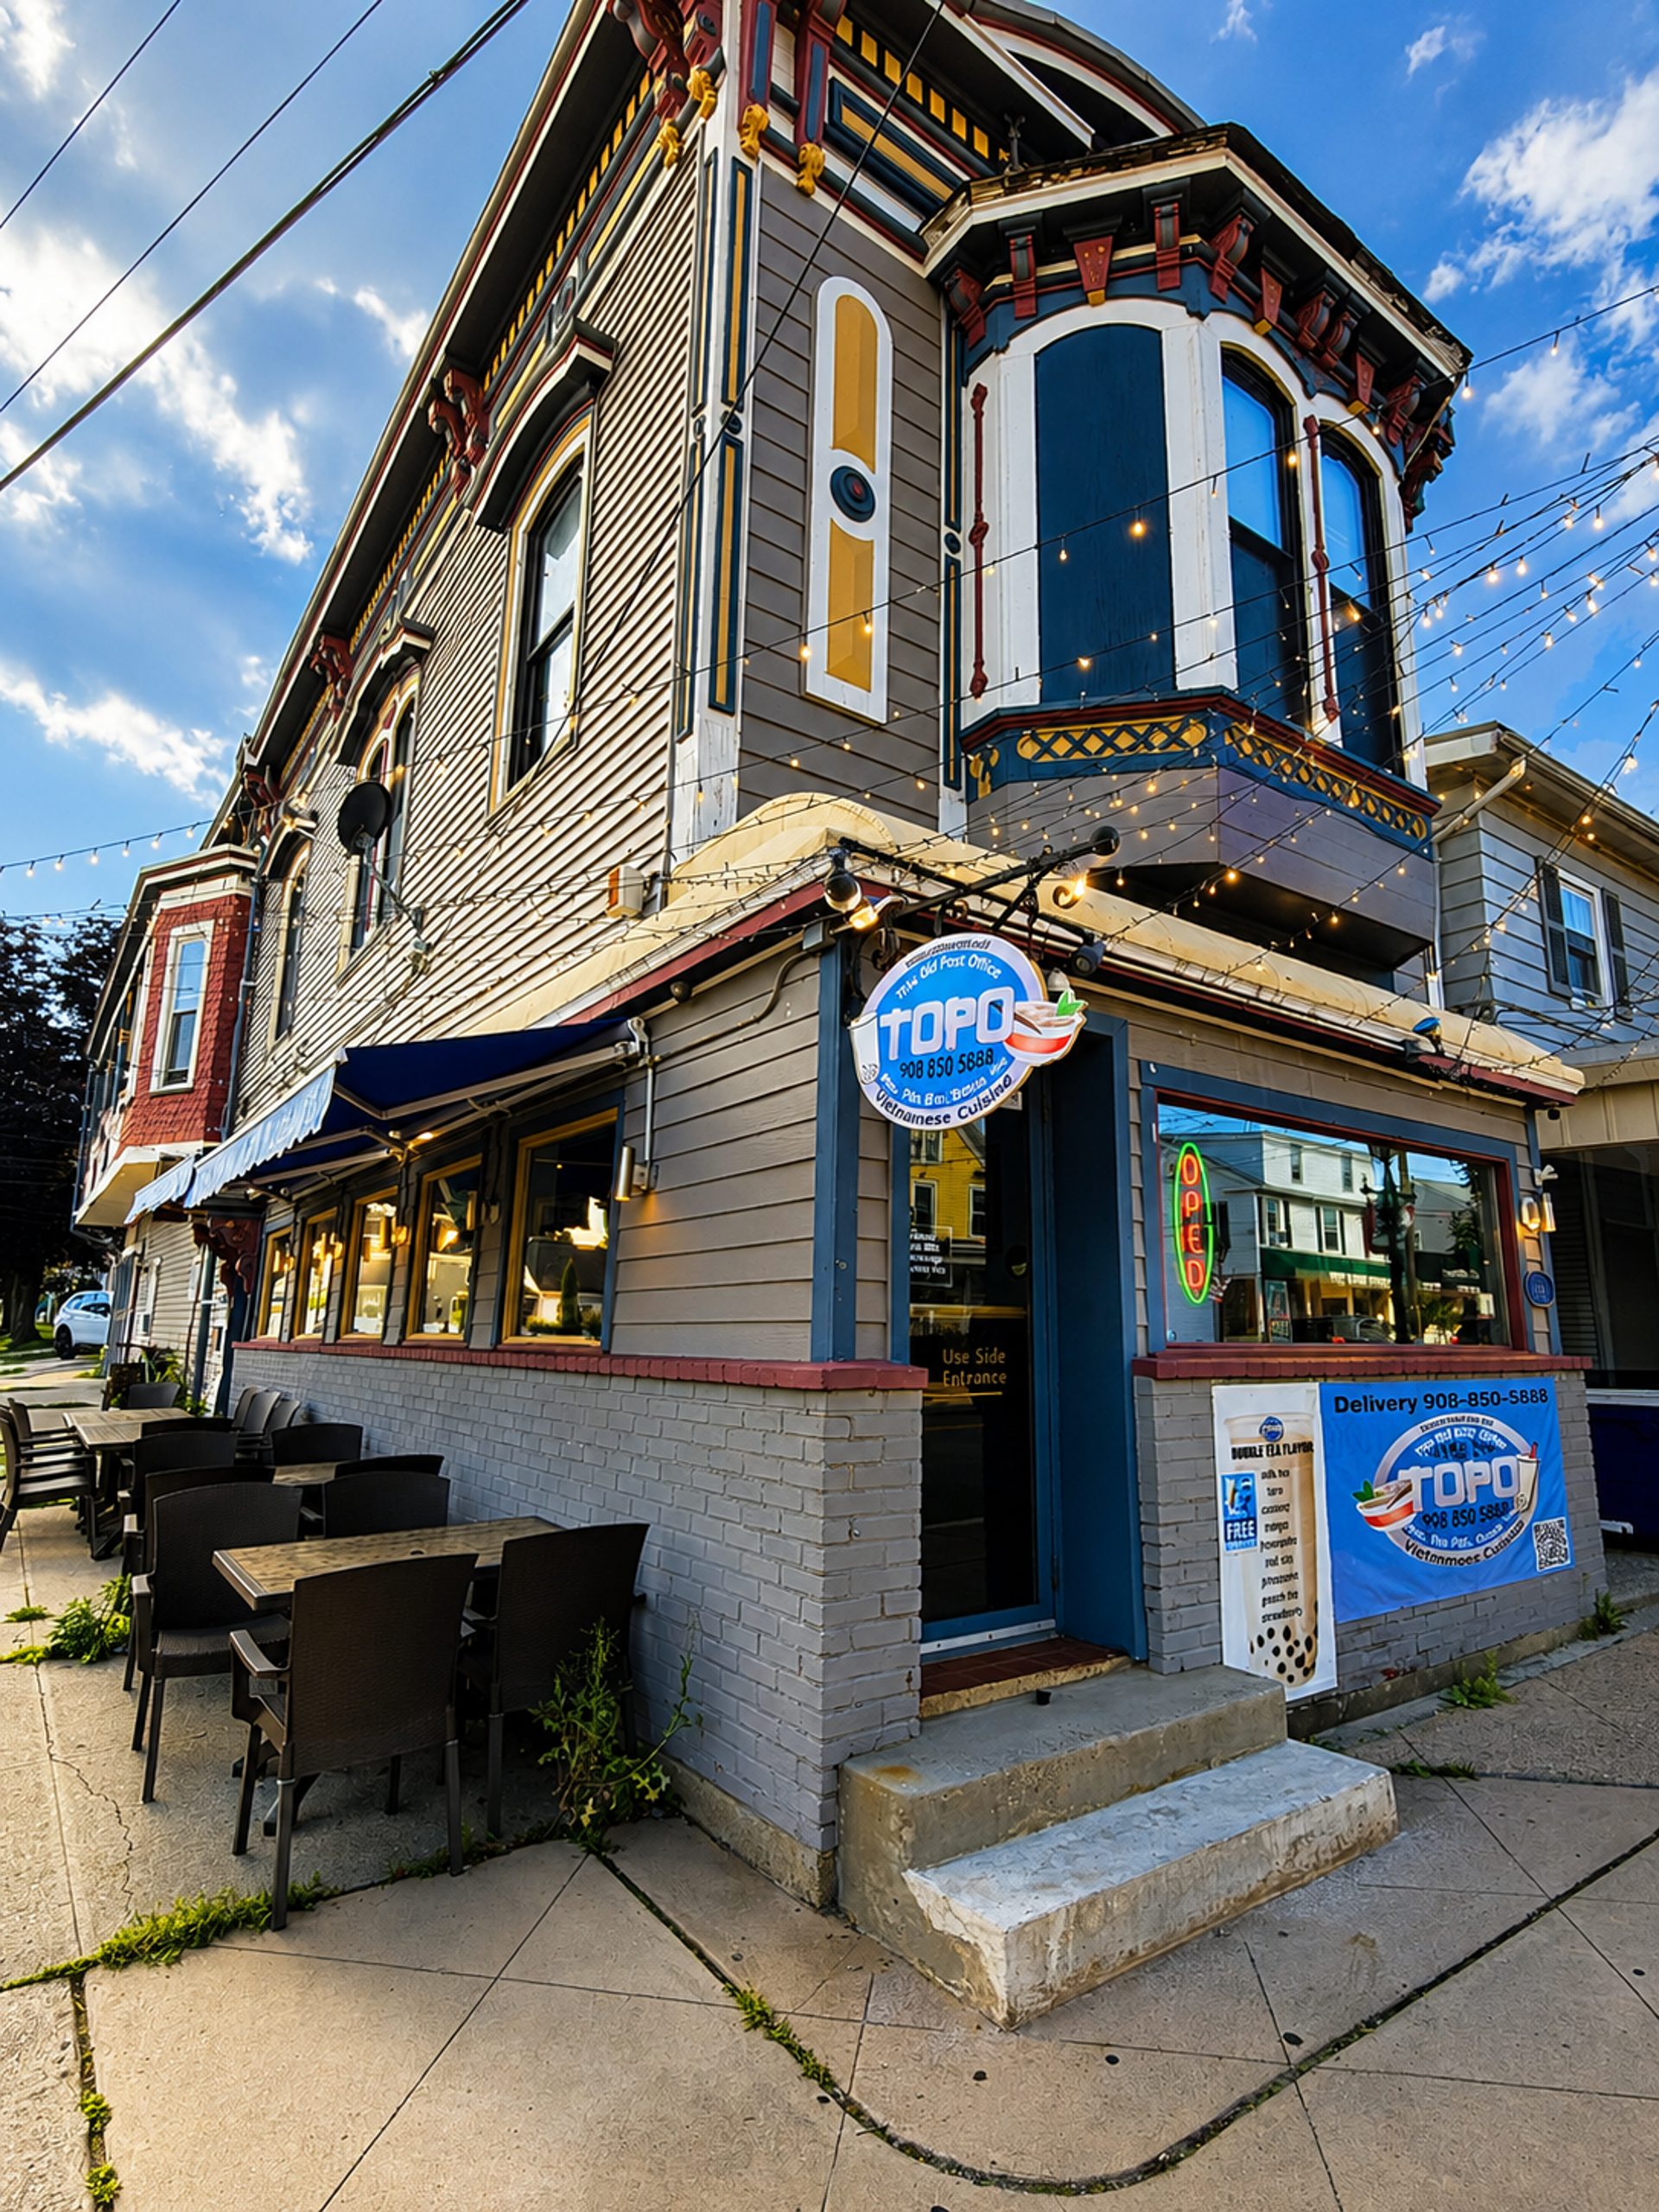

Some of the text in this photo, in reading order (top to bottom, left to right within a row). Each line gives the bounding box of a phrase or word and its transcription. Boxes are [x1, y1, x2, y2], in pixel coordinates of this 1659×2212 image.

[919, 959, 938, 979] Old
[880, 986, 1014, 1061] TOPO
[899, 1047, 994, 1079] 908 850 5888
[876, 1088, 951, 1126] Vietnamese
[943, 1347, 1006, 1364] Use Side
[944, 1370, 1007, 1387] Entrance
[1334, 1389, 1548, 1414] Delivery 908-850-5888
[1398, 1455, 1518, 1511] TOPO
[1227, 1520, 1255, 1541] FREE
